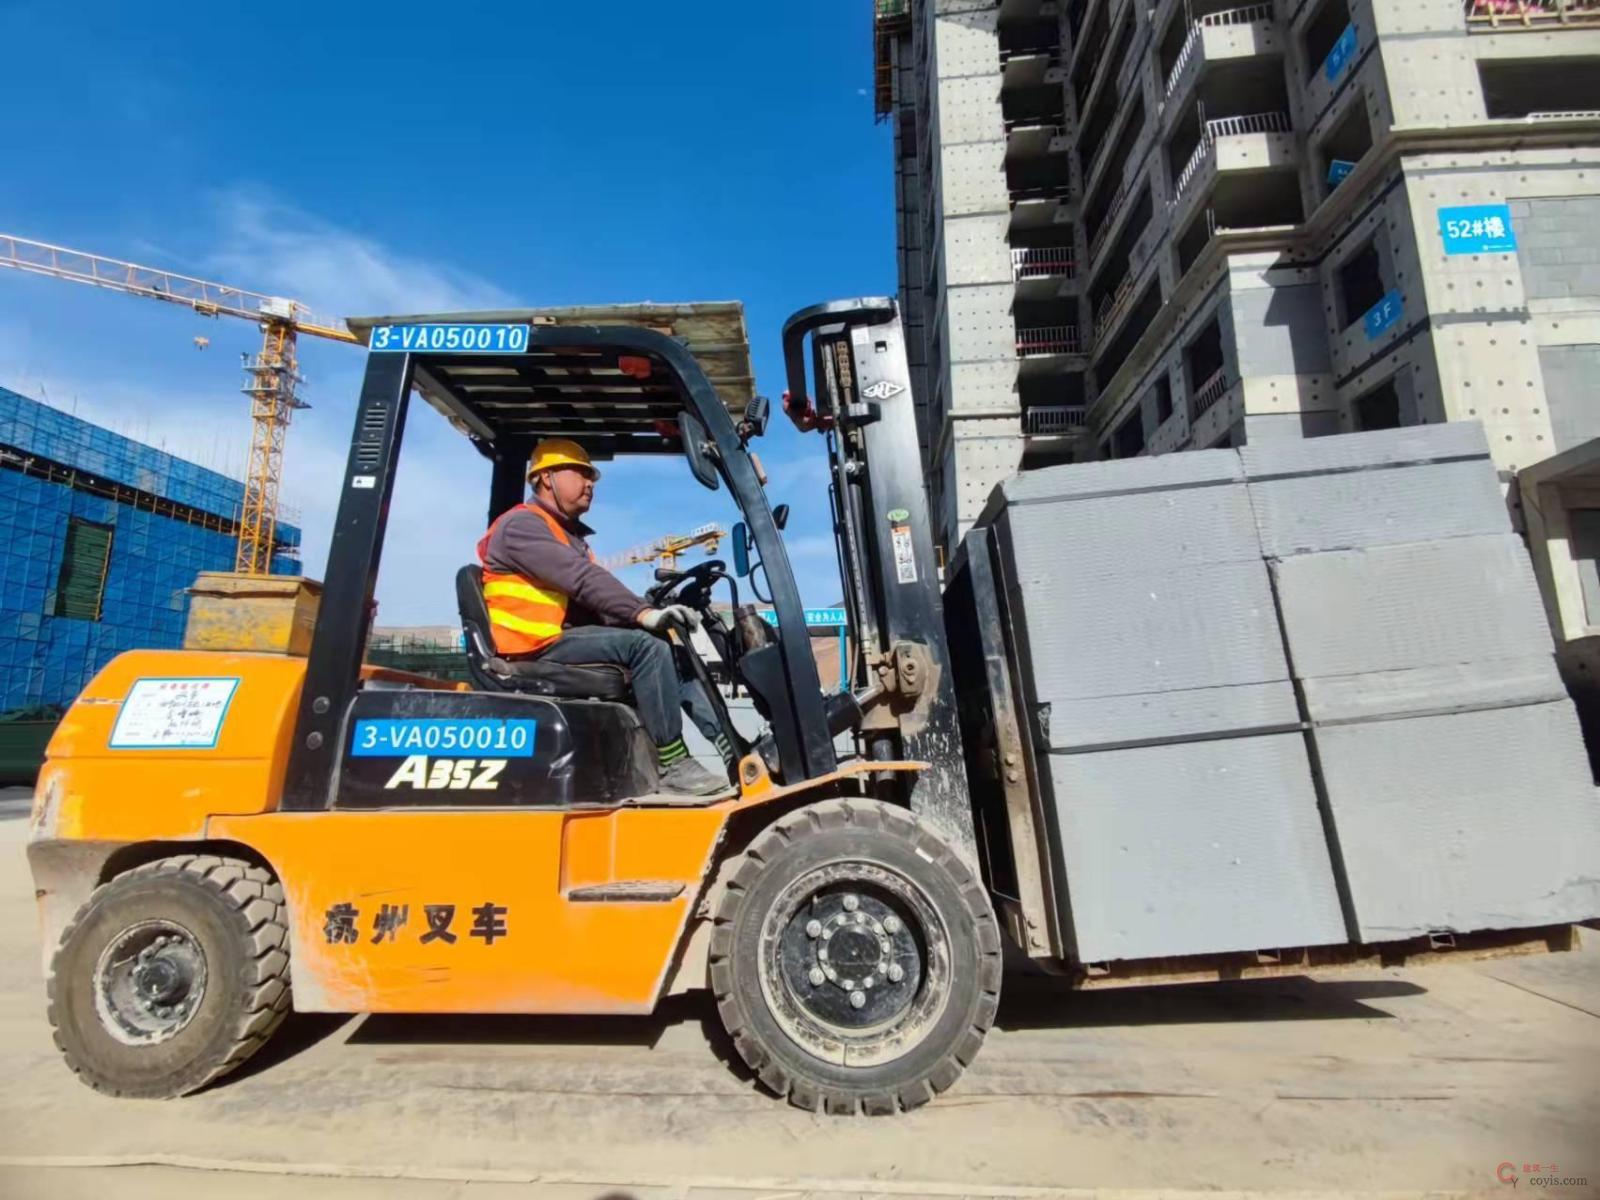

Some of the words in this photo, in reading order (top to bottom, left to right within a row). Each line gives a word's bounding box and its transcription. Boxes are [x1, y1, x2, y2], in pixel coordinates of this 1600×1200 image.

[1446, 216, 1506, 239] 52#楼
[374, 326, 524, 349] 3-VA050010
[361, 725, 528, 749] 3-VA050010
[323, 902, 508, 946] 杭州叉车
